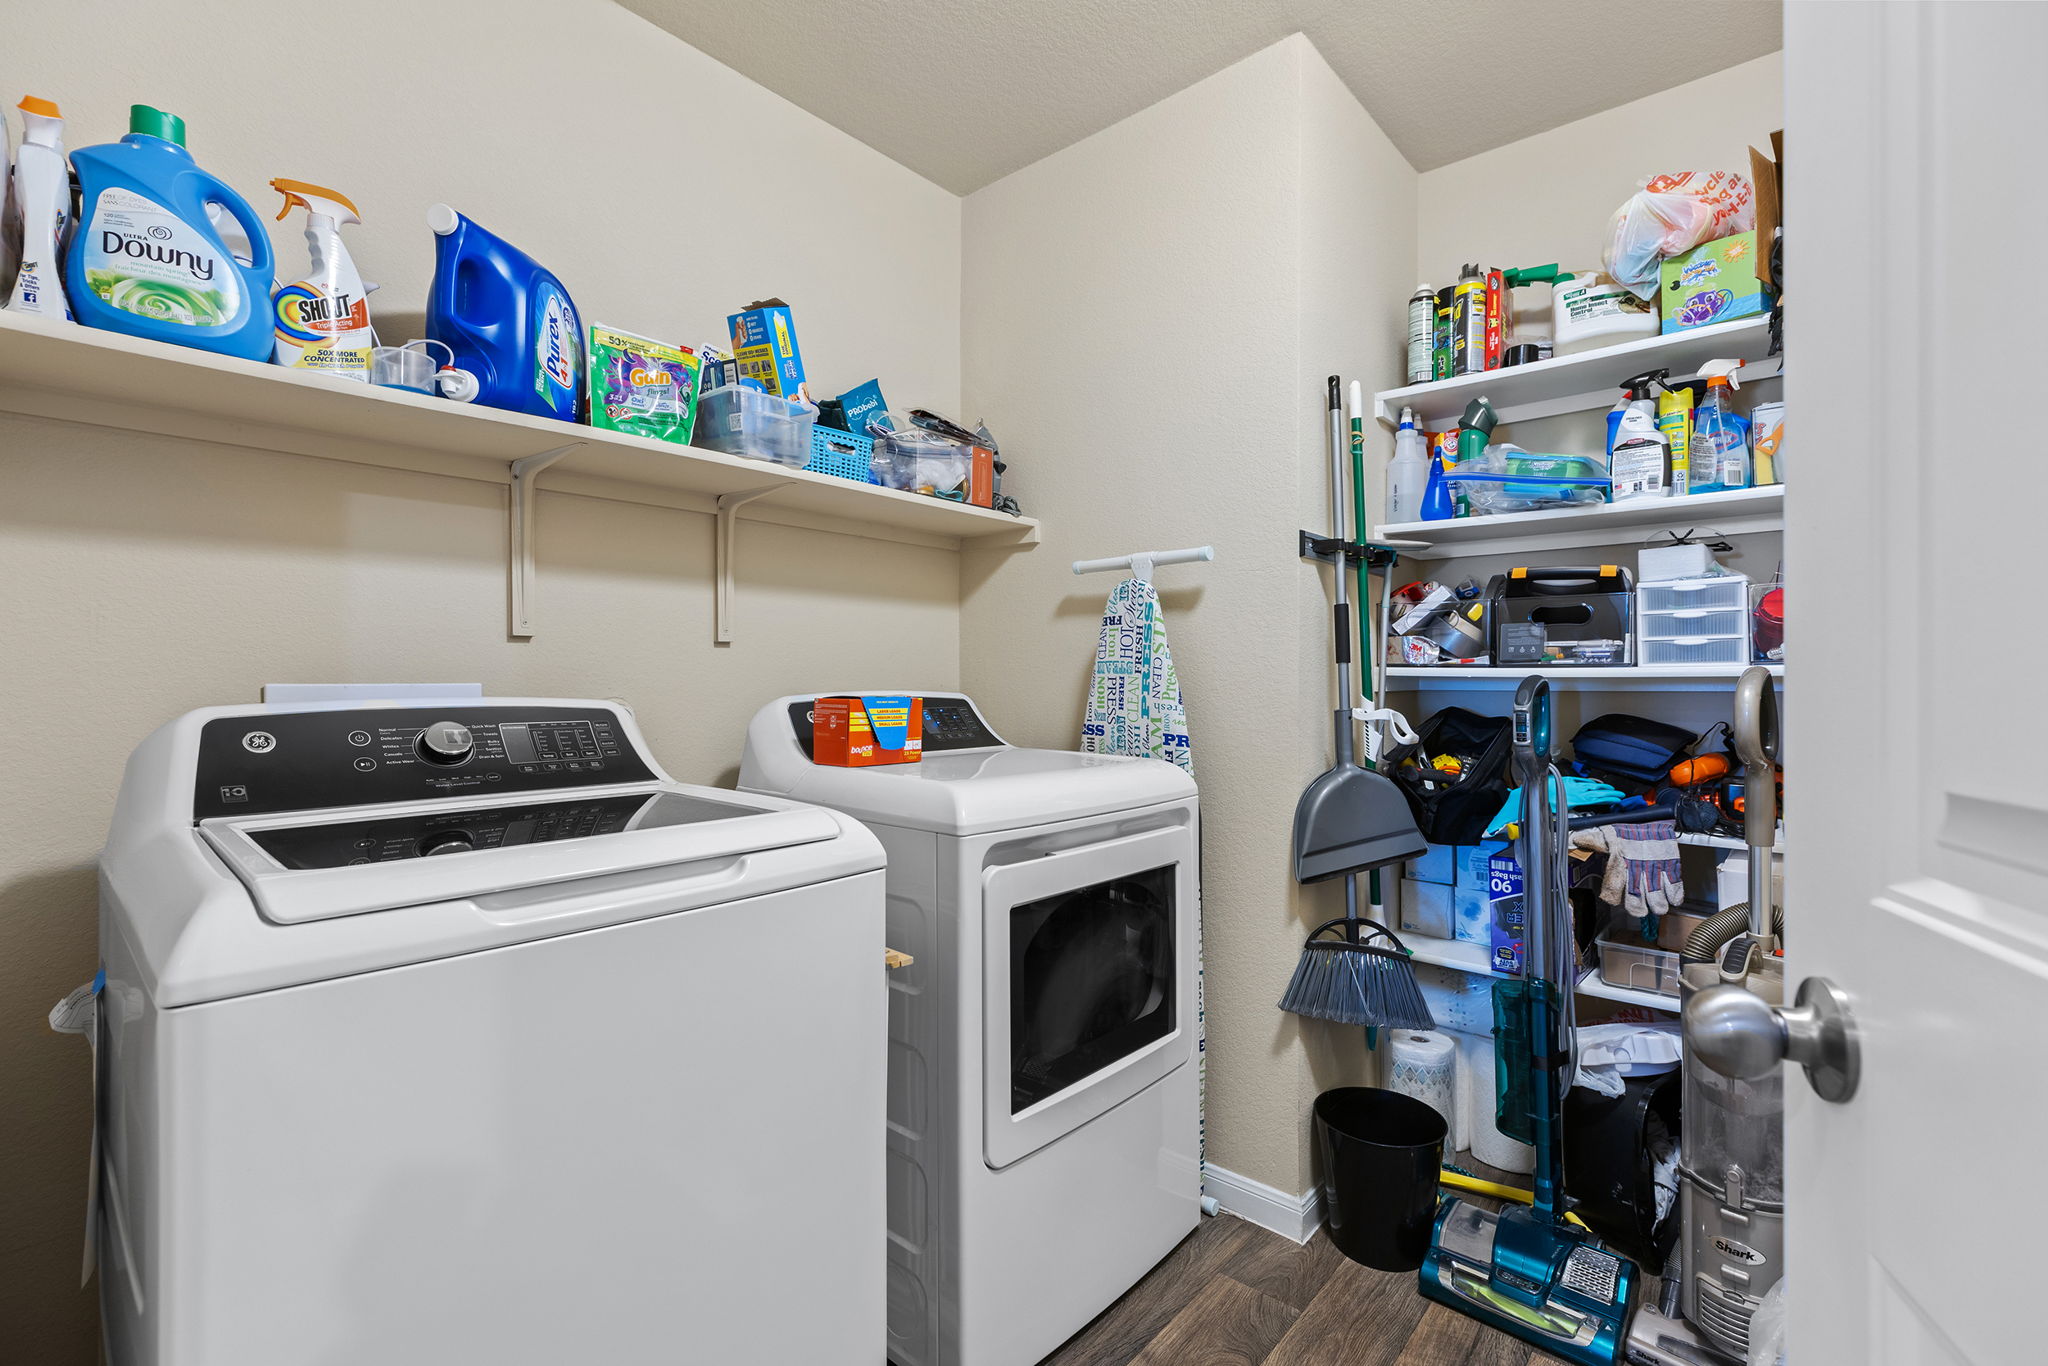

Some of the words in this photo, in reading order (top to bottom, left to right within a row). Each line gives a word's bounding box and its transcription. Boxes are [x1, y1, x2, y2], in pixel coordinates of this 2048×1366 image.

[123, 232, 148, 241] ULTRA
[102, 230, 214, 281] Downy
[298, 294, 349, 323] SHOUT
[1570, 304, 1587, 312] Home
[1588, 300, 1608, 309] Insect
[1570, 307, 1593, 317] Control
[546, 312, 560, 378] Purex
[303, 355, 365, 363] CONCENTRATED
[630, 368, 672, 386] Gain
[1108, 628, 1119, 658] Iron
[1120, 626, 1134, 659] HOT
[1135, 625, 1144, 674] FRESH
[1410, 643, 1423, 652] 3M
[1097, 660, 1133, 675] STEAM
[1141, 601, 1154, 720] PRESS
[1152, 656, 1163, 700] CLEAN
[1097, 675, 1105, 709] IRON
[1107, 676, 1117, 725] PRESS
[1127, 676, 1139, 722] CLEAN
[1490, 870, 1509, 880] Bags
[1490, 878, 1513, 894] 90
[1714, 1239, 1756, 1262] Shark
[1635, 1350, 1660, 1366] Shark
